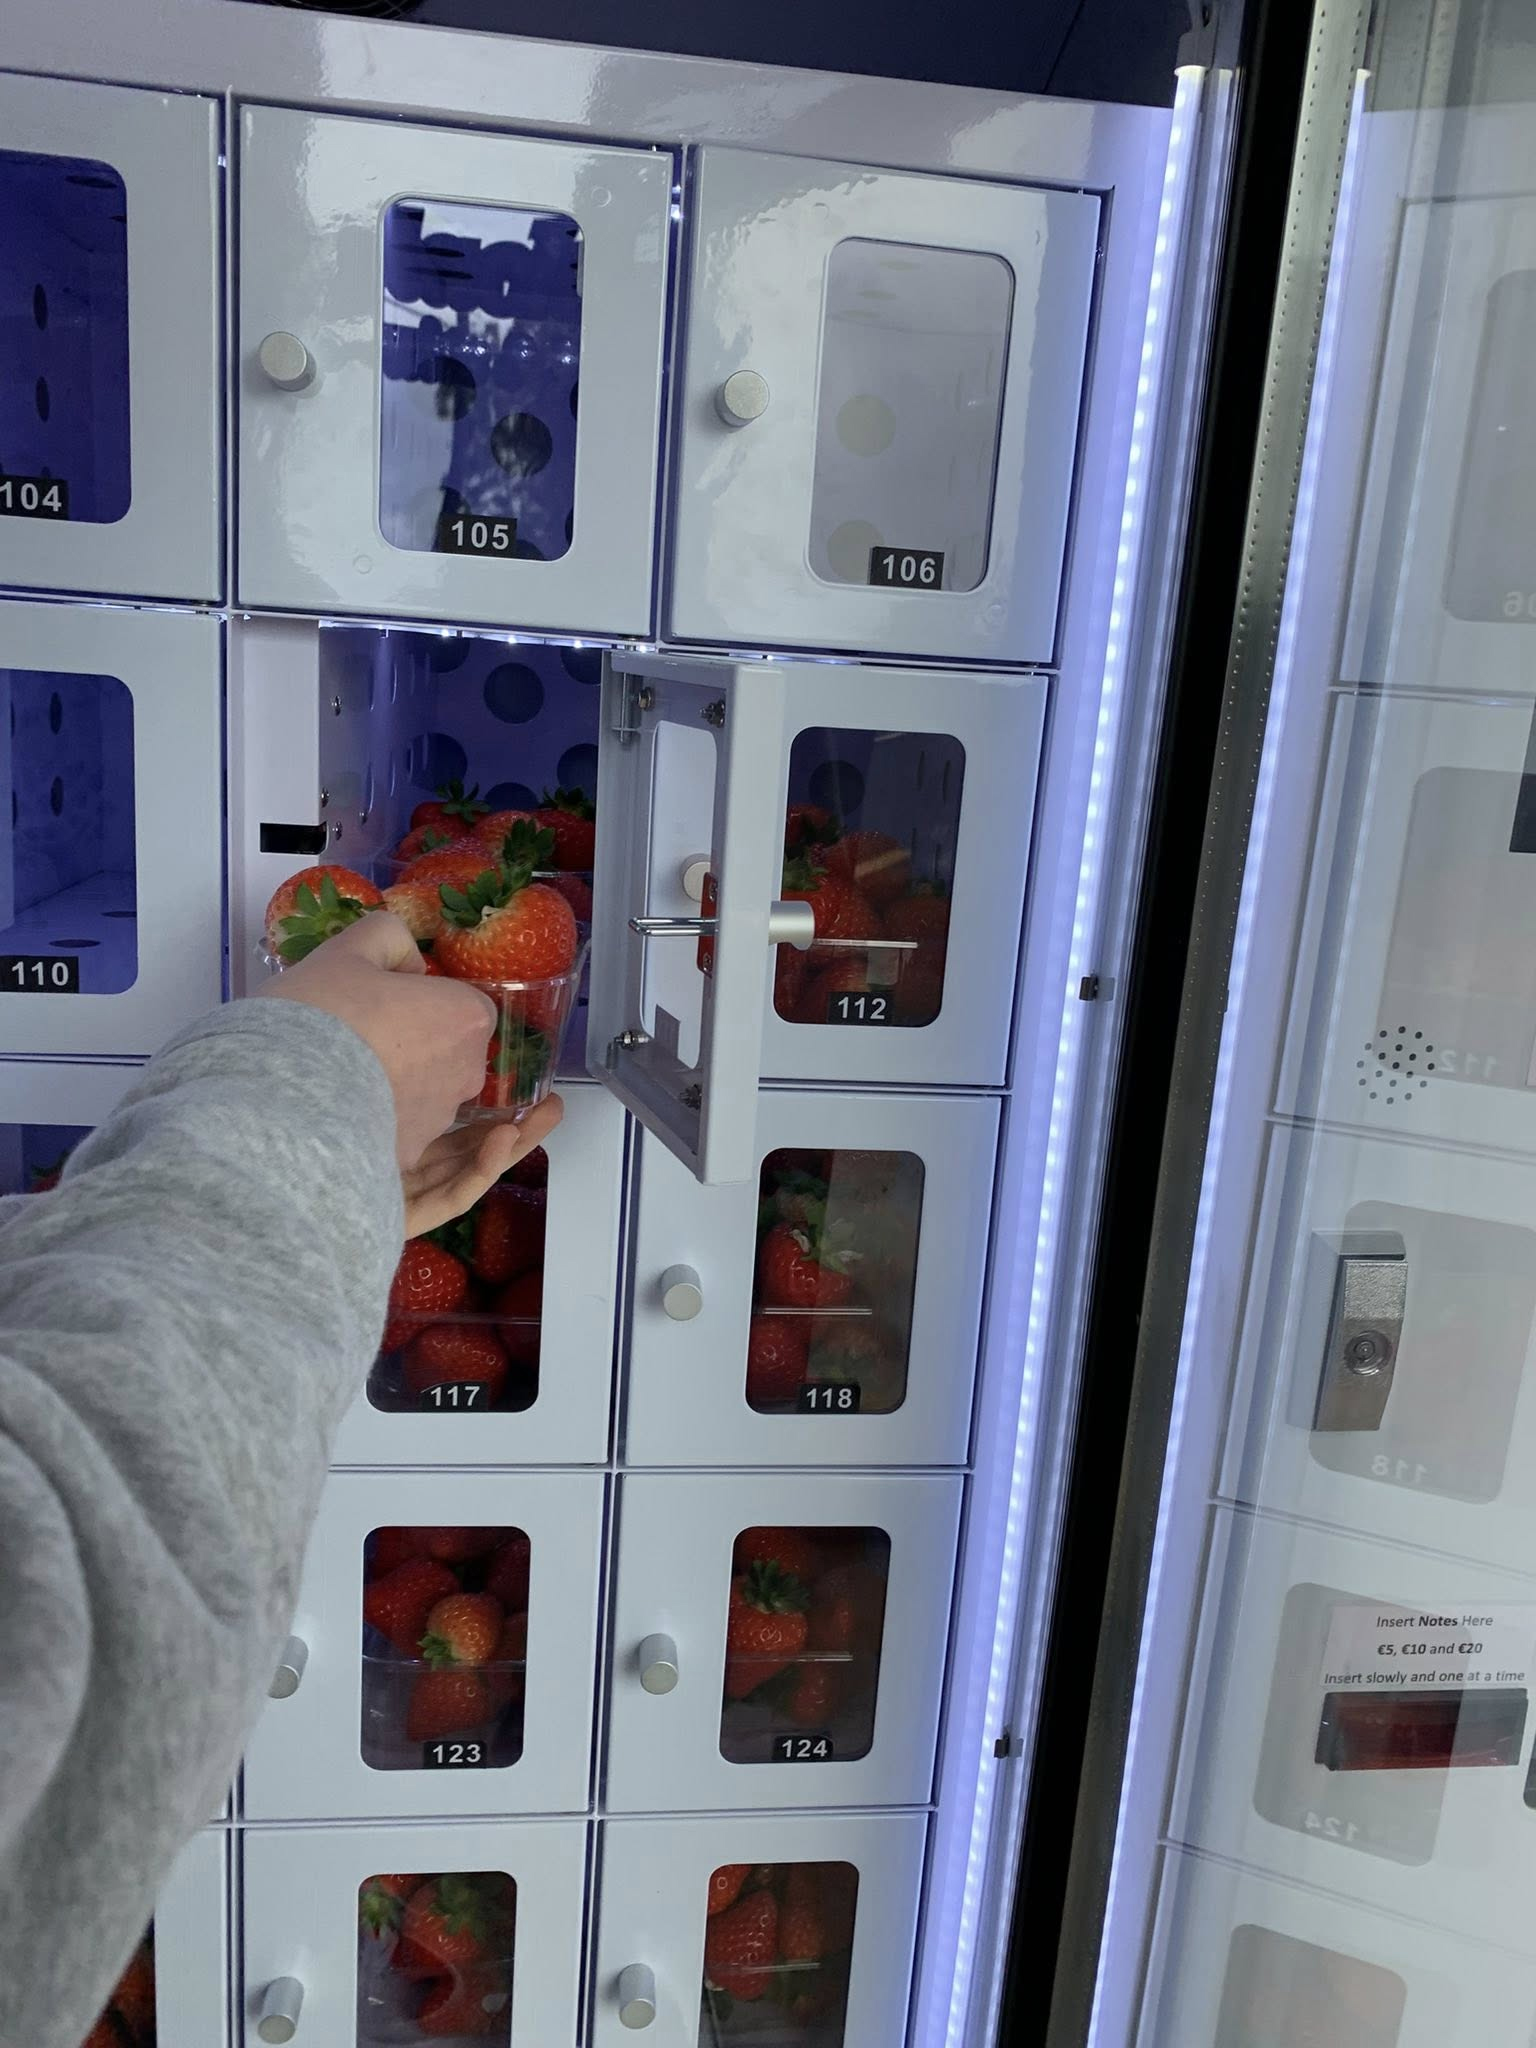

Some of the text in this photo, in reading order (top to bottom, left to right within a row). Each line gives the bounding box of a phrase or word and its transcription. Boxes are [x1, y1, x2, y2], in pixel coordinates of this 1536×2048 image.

[0, 481, 62, 512] 104
[451, 520, 509, 550] 105
[882, 554, 936, 583] 106
[11, 961, 69, 986] 110
[838, 996, 886, 1019] 112
[431, 1385, 480, 1406] 117
[806, 1388, 852, 1408] 118
[1376, 1615, 1494, 1628] Insert Notes Here
[1377, 1643, 1483, 1656] €5, €10 and €20
[1324, 1670, 1525, 1684] Insert slowly and one at a time
[432, 1744, 481, 1764] 123
[782, 1740, 828, 1758] 124
